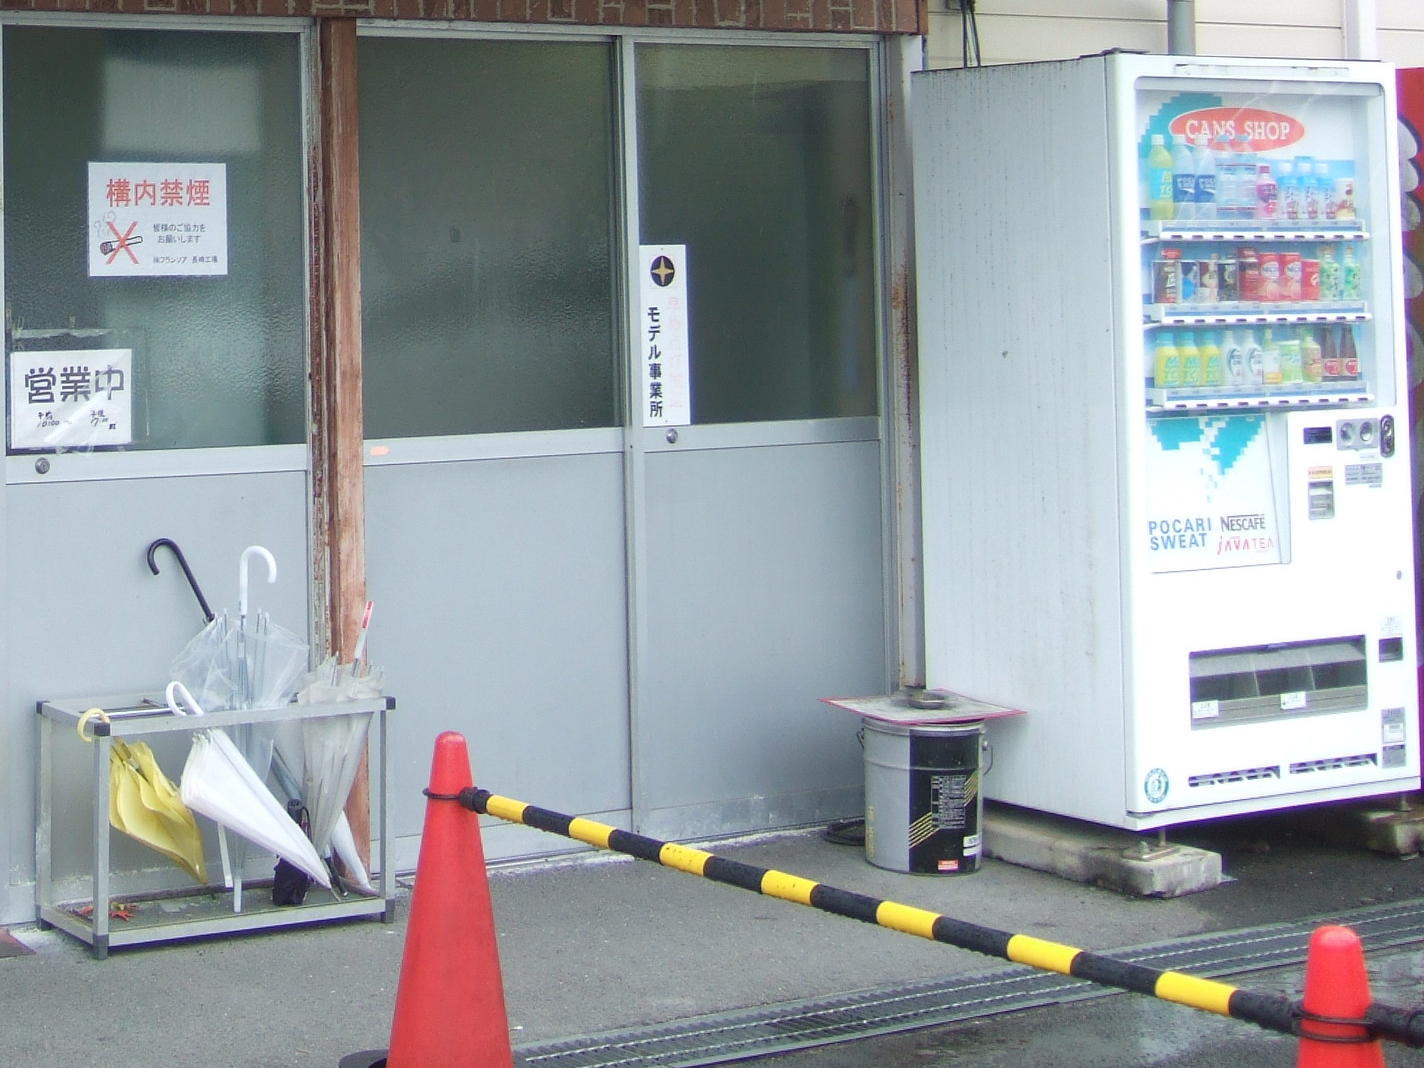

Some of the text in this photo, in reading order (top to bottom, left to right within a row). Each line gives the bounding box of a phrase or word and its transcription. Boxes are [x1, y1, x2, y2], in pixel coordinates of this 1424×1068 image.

[1185, 119, 1291, 141] CANS SHOP
[106, 178, 211, 208] 構内禁煙
[152, 223, 207, 233] 皆様のご協力を
[157, 234, 201, 244] お願いします
[647, 306, 664, 419] モデル事業所
[24, 364, 125, 405] 営業中
[1148, 516, 1212, 535] POCARI
[1149, 532, 1208, 551] SWEAT
